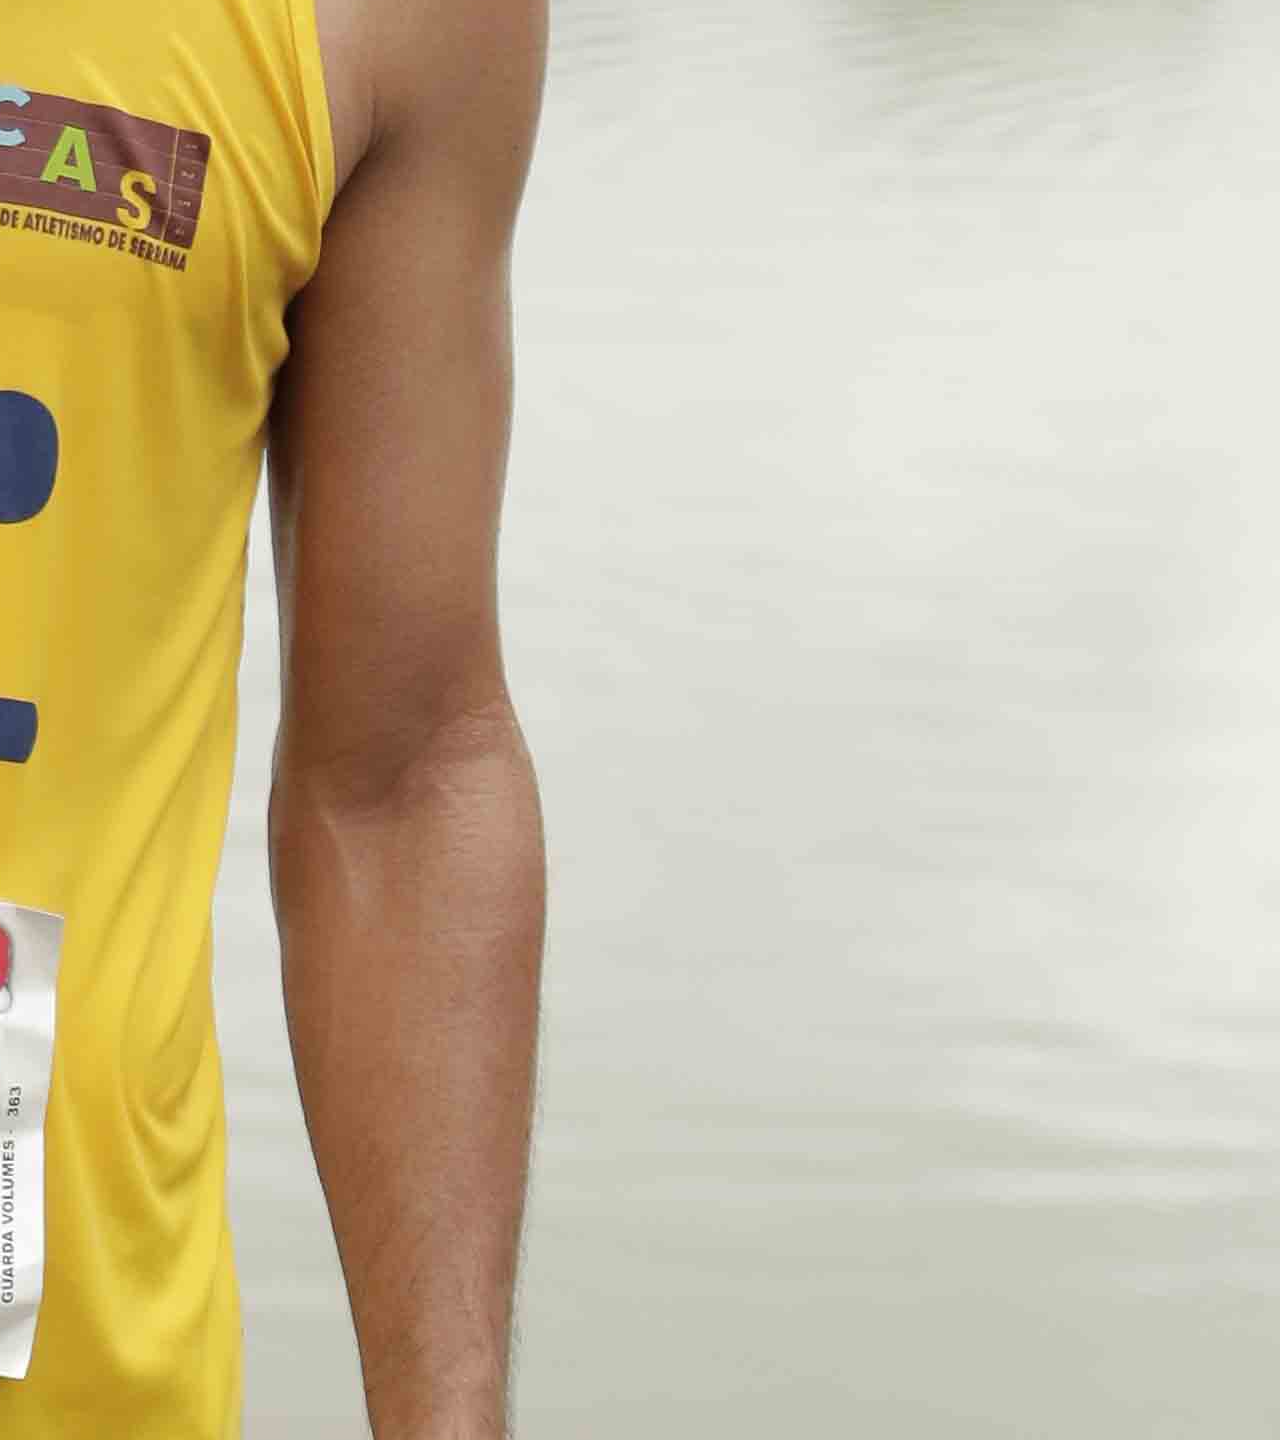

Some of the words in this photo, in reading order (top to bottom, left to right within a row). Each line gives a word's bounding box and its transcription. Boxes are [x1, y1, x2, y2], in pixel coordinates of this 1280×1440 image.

[0, 207, 20, 228] DE
[24, 212, 105, 246] ATLETISMO
[108, 228, 127, 251] DE
[129, 234, 188, 273] SERRANA
[7, 1086, 22, 1117] 363
[1, 1140, 15, 1225] VOLUMES
[1, 1230, 14, 1304] GUARDA
